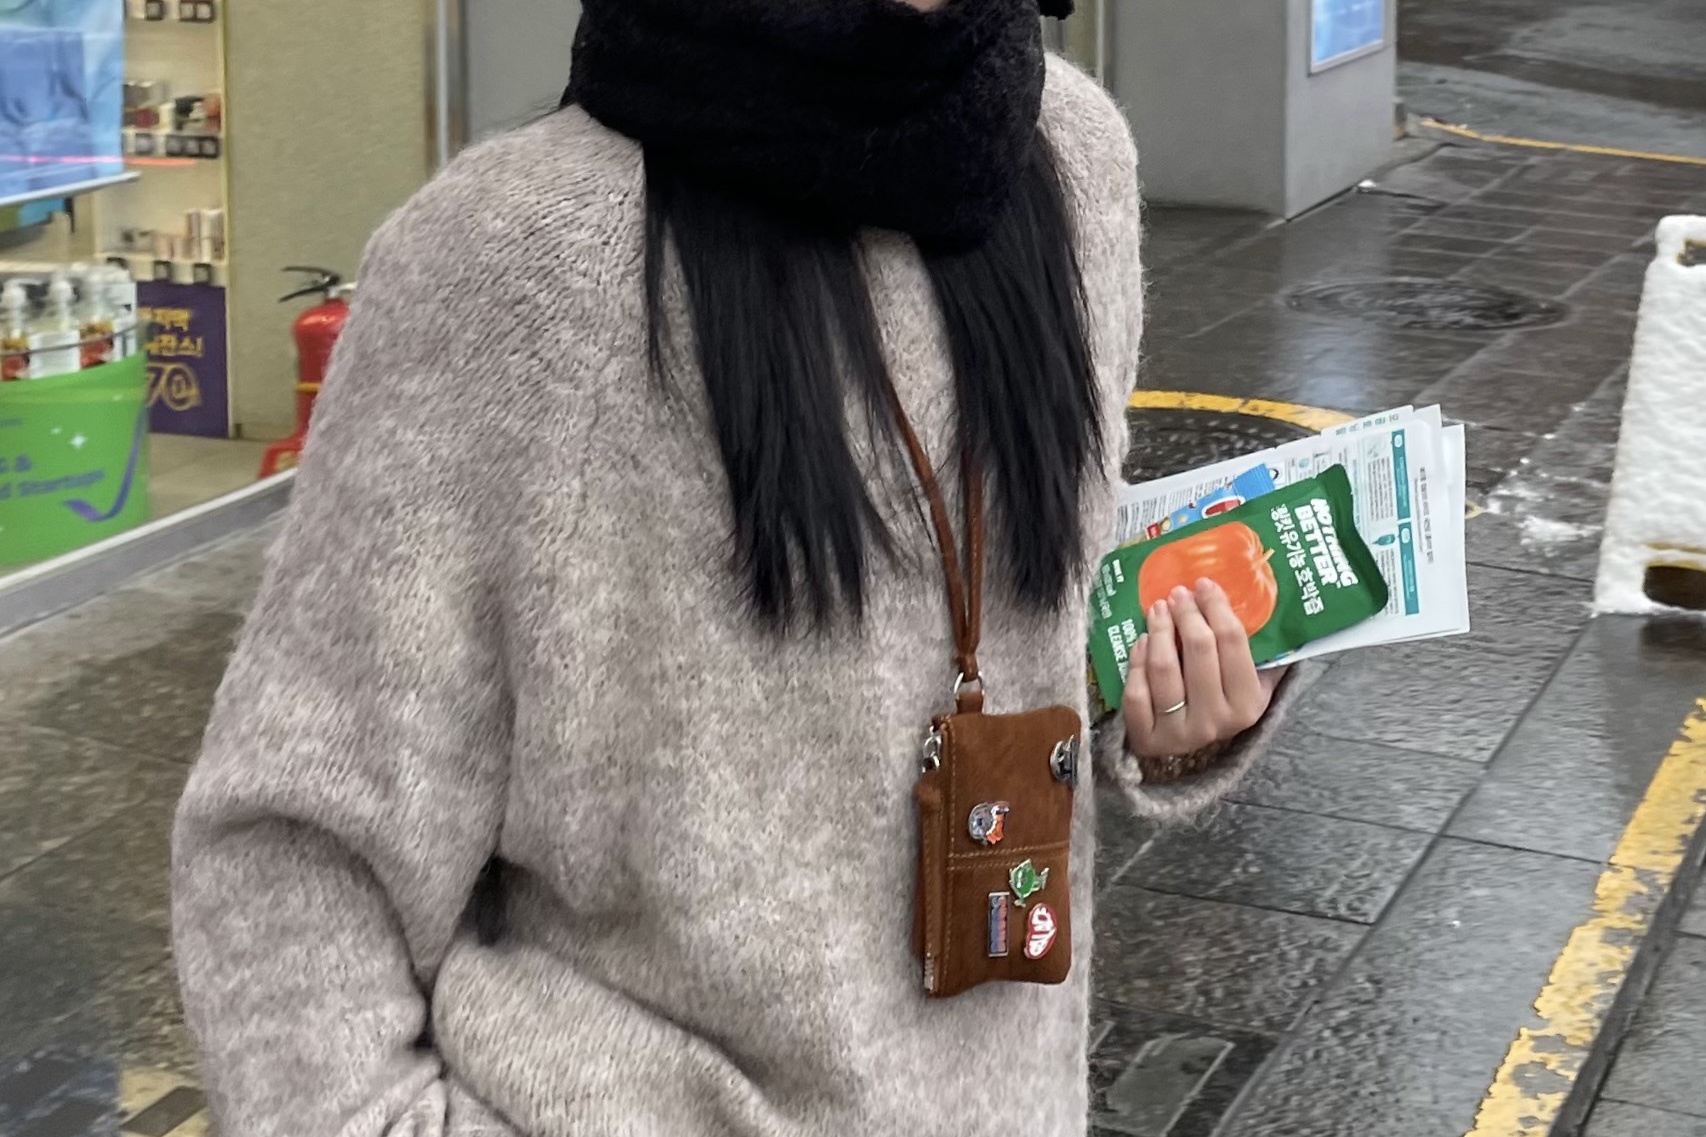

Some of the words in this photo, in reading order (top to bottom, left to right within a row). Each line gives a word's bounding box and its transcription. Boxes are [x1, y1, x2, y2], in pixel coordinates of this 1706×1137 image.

[1279, 530, 1307, 569] 유기농
[1294, 566, 1325, 616] 호박즙
[1294, 504, 1338, 587] BETTER
[1310, 498, 1359, 588] NOTHING
[1107, 624, 1128, 662] CLEANSE
